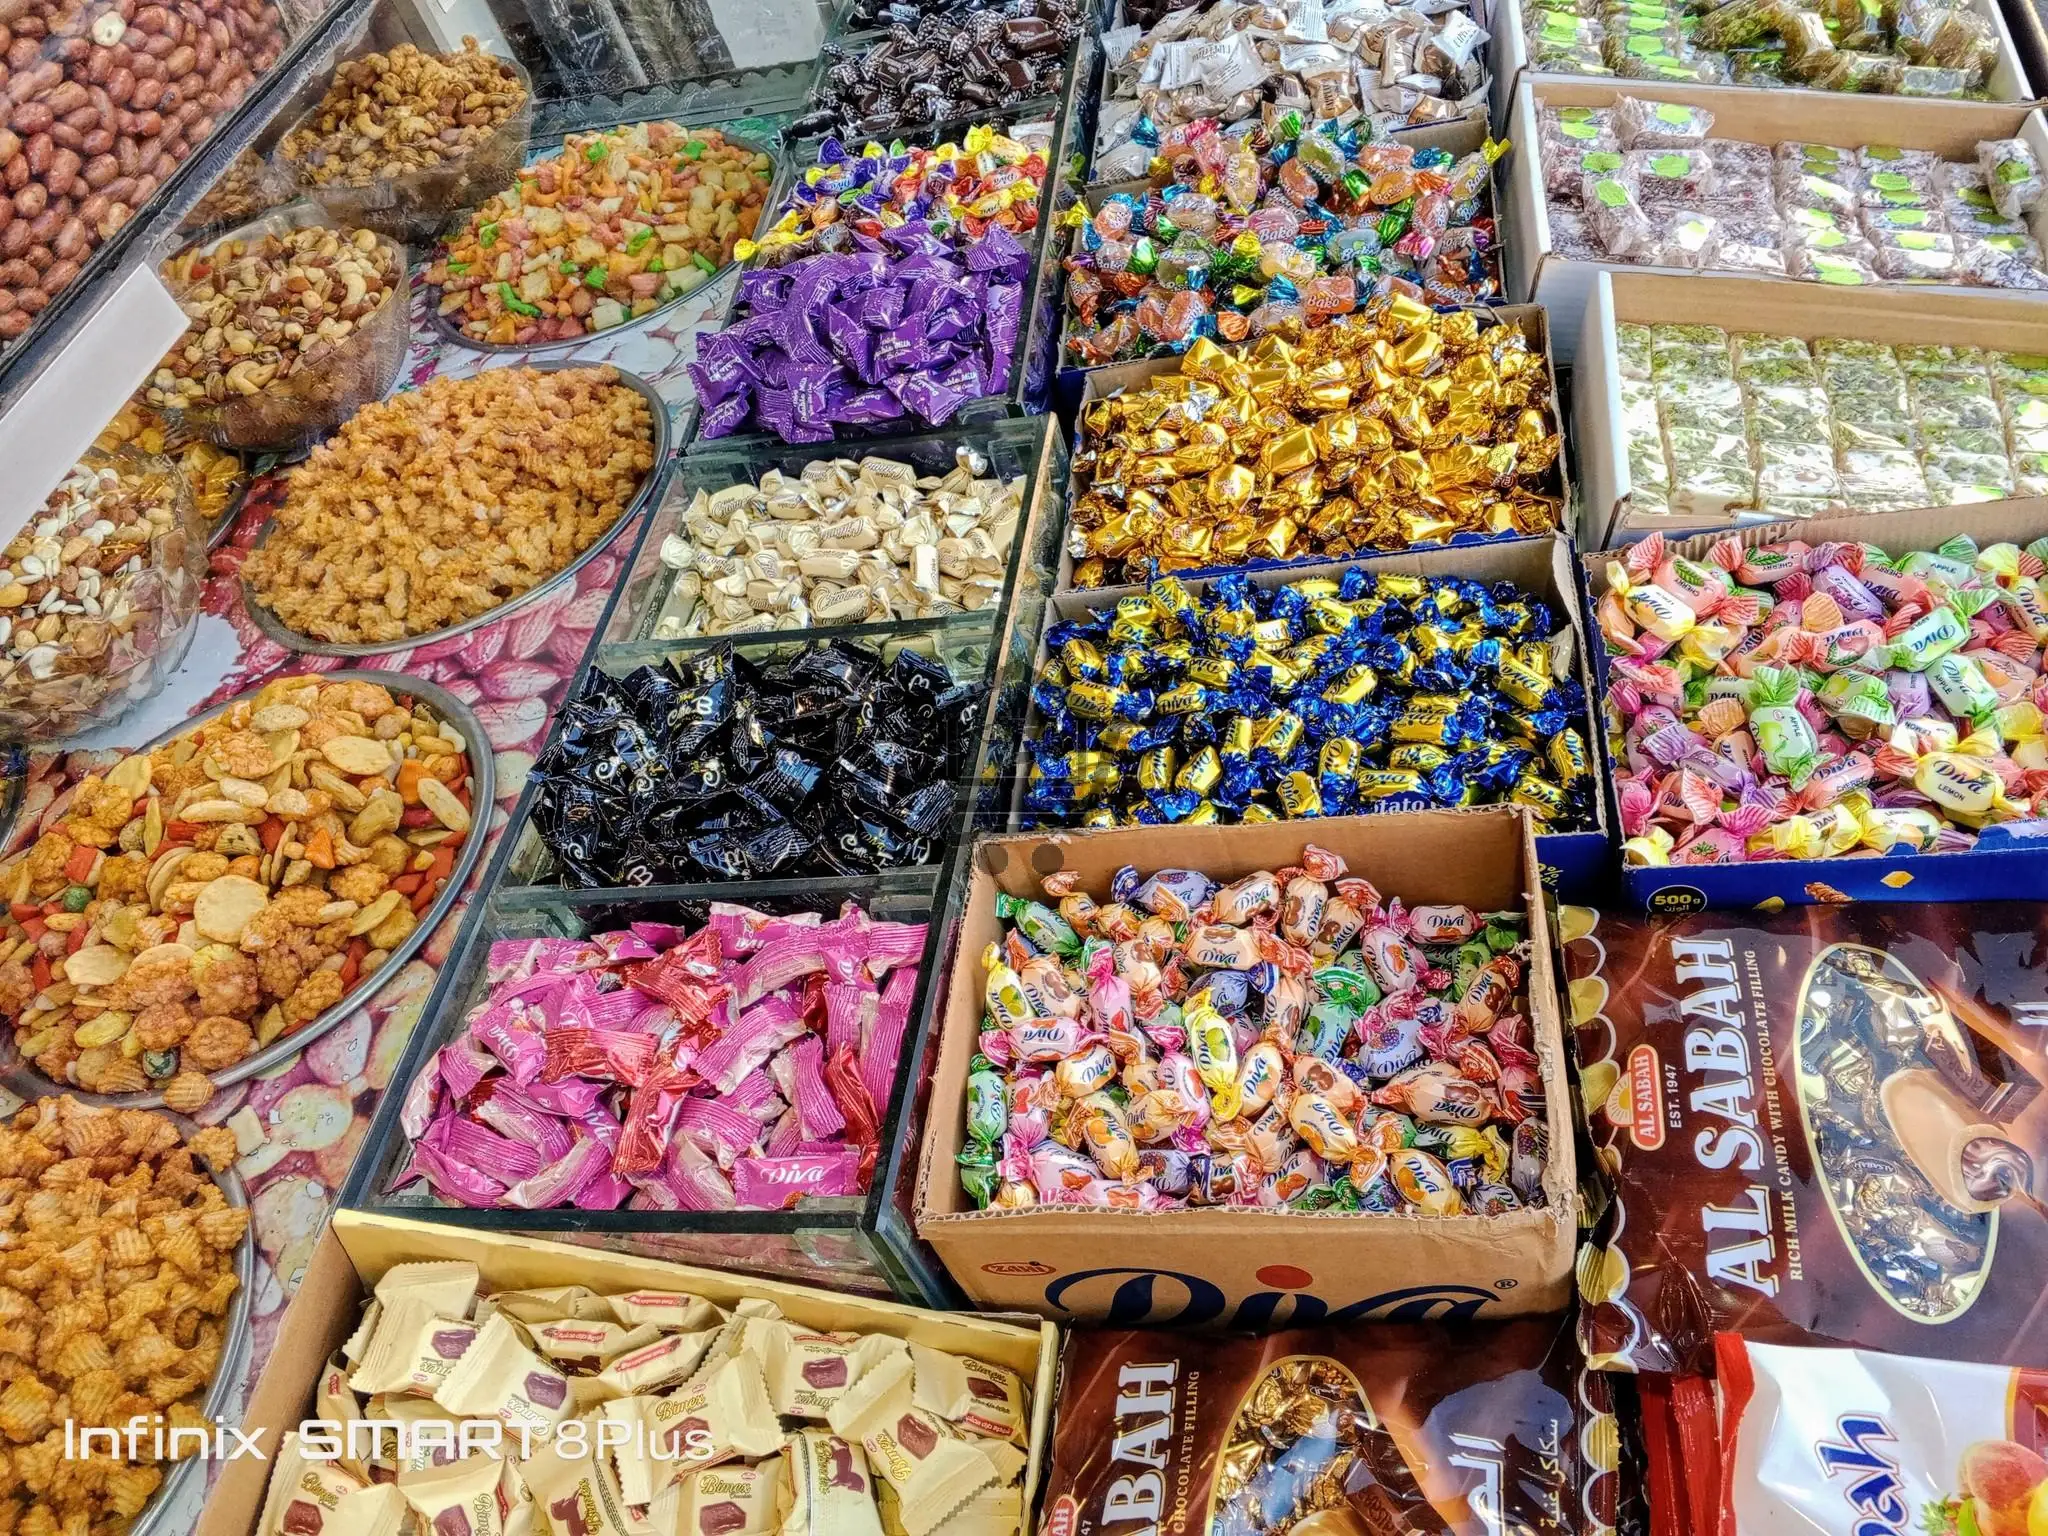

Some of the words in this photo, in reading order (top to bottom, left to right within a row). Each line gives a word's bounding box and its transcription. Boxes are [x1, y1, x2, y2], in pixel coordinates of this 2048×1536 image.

[1466, 163, 1489, 193] Bako
[1260, 225, 1296, 241] Bako
[1306, 295, 1341, 309] Bako
[1150, 582, 1178, 609] Diva
[1637, 592, 1673, 620] Diva
[2016, 586, 2048, 625] Diva
[1910, 624, 1956, 653] Diva
[1502, 666, 1546, 695] Diva
[1934, 674, 1953, 695] APPLE
[1070, 693, 1107, 712] Diva
[1161, 695, 1193, 713] Diva
[1789, 715, 1803, 737] APPLE
[1812, 755, 1858, 780] Diva
[1933, 760, 1988, 795] Diva
[1285, 776, 1300, 810] Diva
[1836, 776, 1866, 792] CHERRY
[1938, 784, 1966, 801] LEMON
[1235, 885, 1273, 911] Diva
[1307, 895, 1324, 937] Diva
[1427, 914, 1466, 928] Diva
[1198, 949, 1240, 965] Diva
[1468, 969, 1493, 1005] Diva
[1745, 950, 1766, 1001] FILLING
[1022, 1028, 1066, 1044] Diva
[1199, 1030, 1213, 1072] Diva
[1321, 1025, 1347, 1065] Diva
[1754, 1001, 1776, 1088] CHOCOLATE
[1081, 1053, 1113, 1083] Diva
[1376, 1046, 1416, 1076] Diva
[1671, 937, 1765, 1170] SABAH
[1244, 1055, 1267, 1098] Diva
[1634, 1054, 1653, 1112] SABAH
[1664, 1063, 1680, 1094] 1947
[1312, 1102, 1347, 1136] Diva
[1430, 1101, 1481, 1120] Diva
[1668, 1099, 1682, 1129] EST.
[1767, 1088, 1784, 1131] WITH
[1638, 1114, 1656, 1139] AL
[761, 1163, 826, 1185] Diva
[1262, 1154, 1300, 1188] Diva
[1406, 1157, 1444, 1194] Diva
[1774, 1135, 1792, 1187] CANDY
[1781, 1190, 1800, 1232] MILK
[1702, 1184, 1780, 1298] AL
[1786, 1237, 1804, 1281] RICH
[656, 1393, 706, 1421] Bimex
[876, 1432, 913, 1481] Bimex
[1172, 1434, 1195, 1534] CHOCOLATE
[1184, 1371, 1200, 1432] FILLING
[700, 1474, 753, 1496] Bimex
